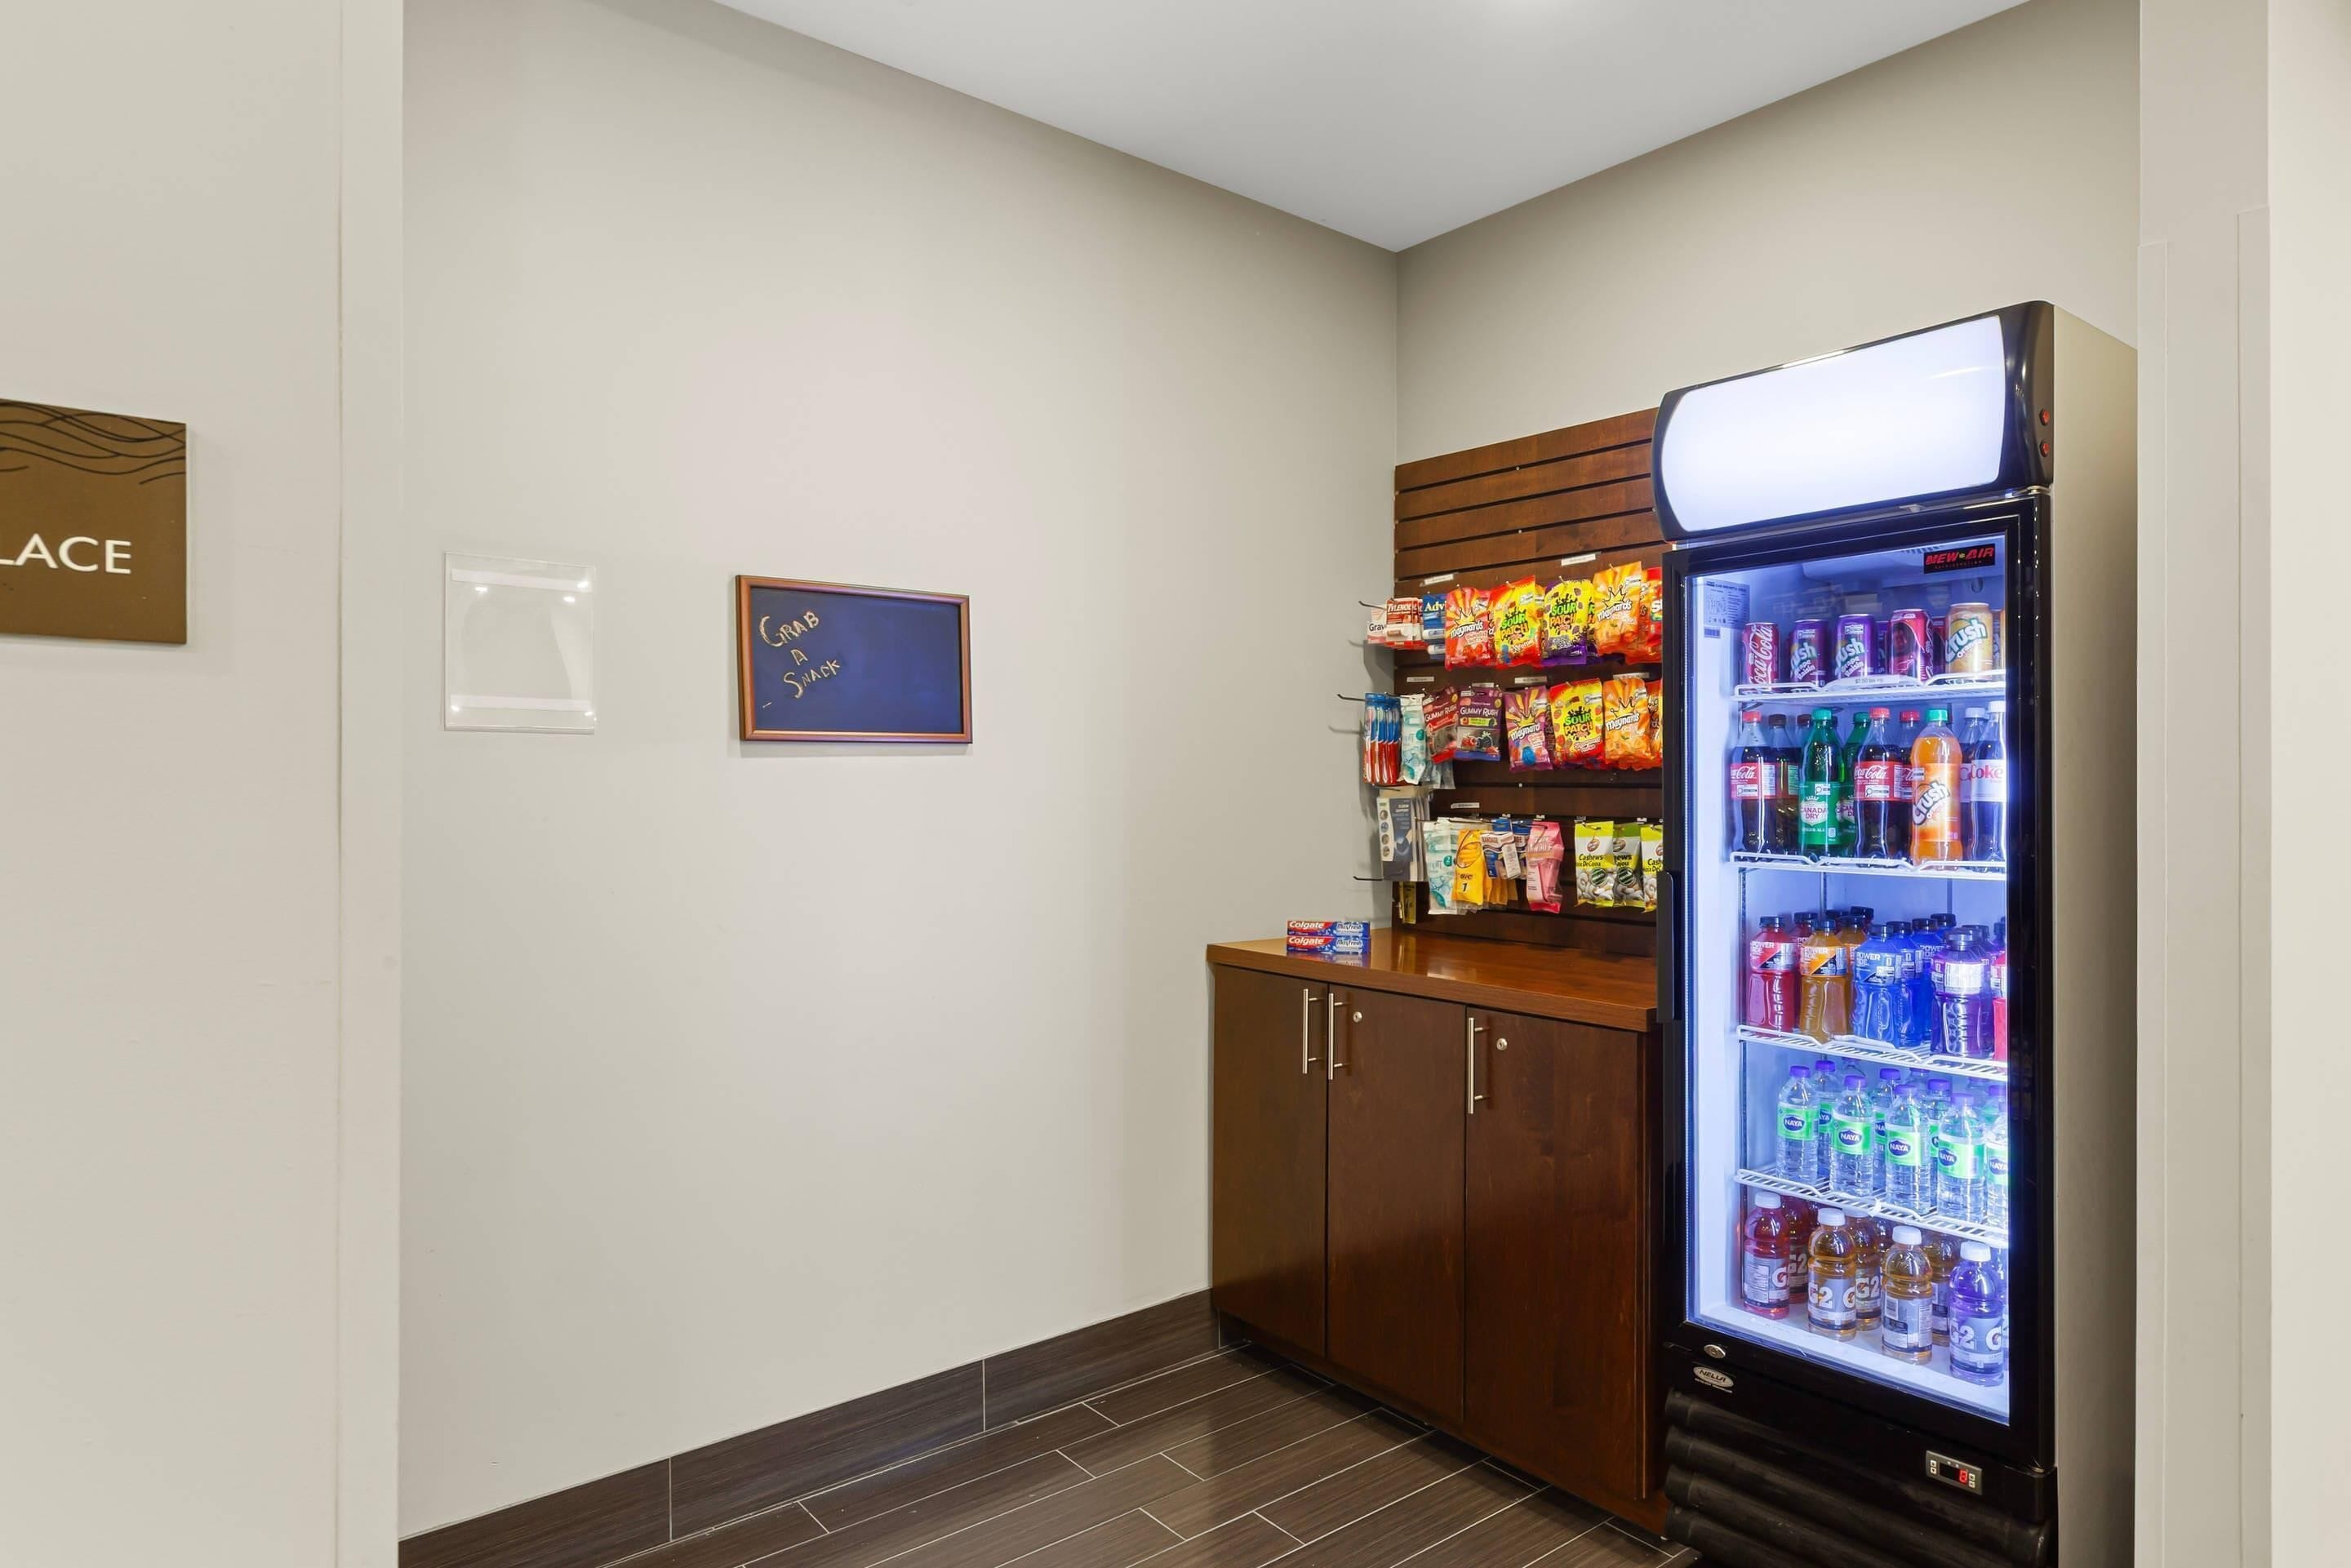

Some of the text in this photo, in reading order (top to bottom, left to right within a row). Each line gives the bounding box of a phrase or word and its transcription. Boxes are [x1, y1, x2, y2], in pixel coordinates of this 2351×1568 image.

[1424, 601, 1447, 611] Adv
[1552, 602, 1577, 615] SOUR
[1502, 612, 1527, 629] SOUR
[1550, 613, 1575, 624] PATCH
[758, 611, 820, 647] GRAB
[1500, 622, 1530, 637] PATCH
[790, 648, 808, 666] A
[783, 659, 842, 699] SNACK
[1564, 713, 1593, 726] SOUR
[1565, 722, 1594, 734] PATCH
[1913, 780, 1951, 826] Crush
[1289, 921, 1325, 931] Colgate
[1288, 935, 1324, 946] Colgate
[1784, 1118, 1803, 1127] NAYA
[1840, 1132, 1860, 1142] NAYA
[1889, 1143, 1909, 1153] NAYA
[1939, 1150, 1956, 1162] NAYA
